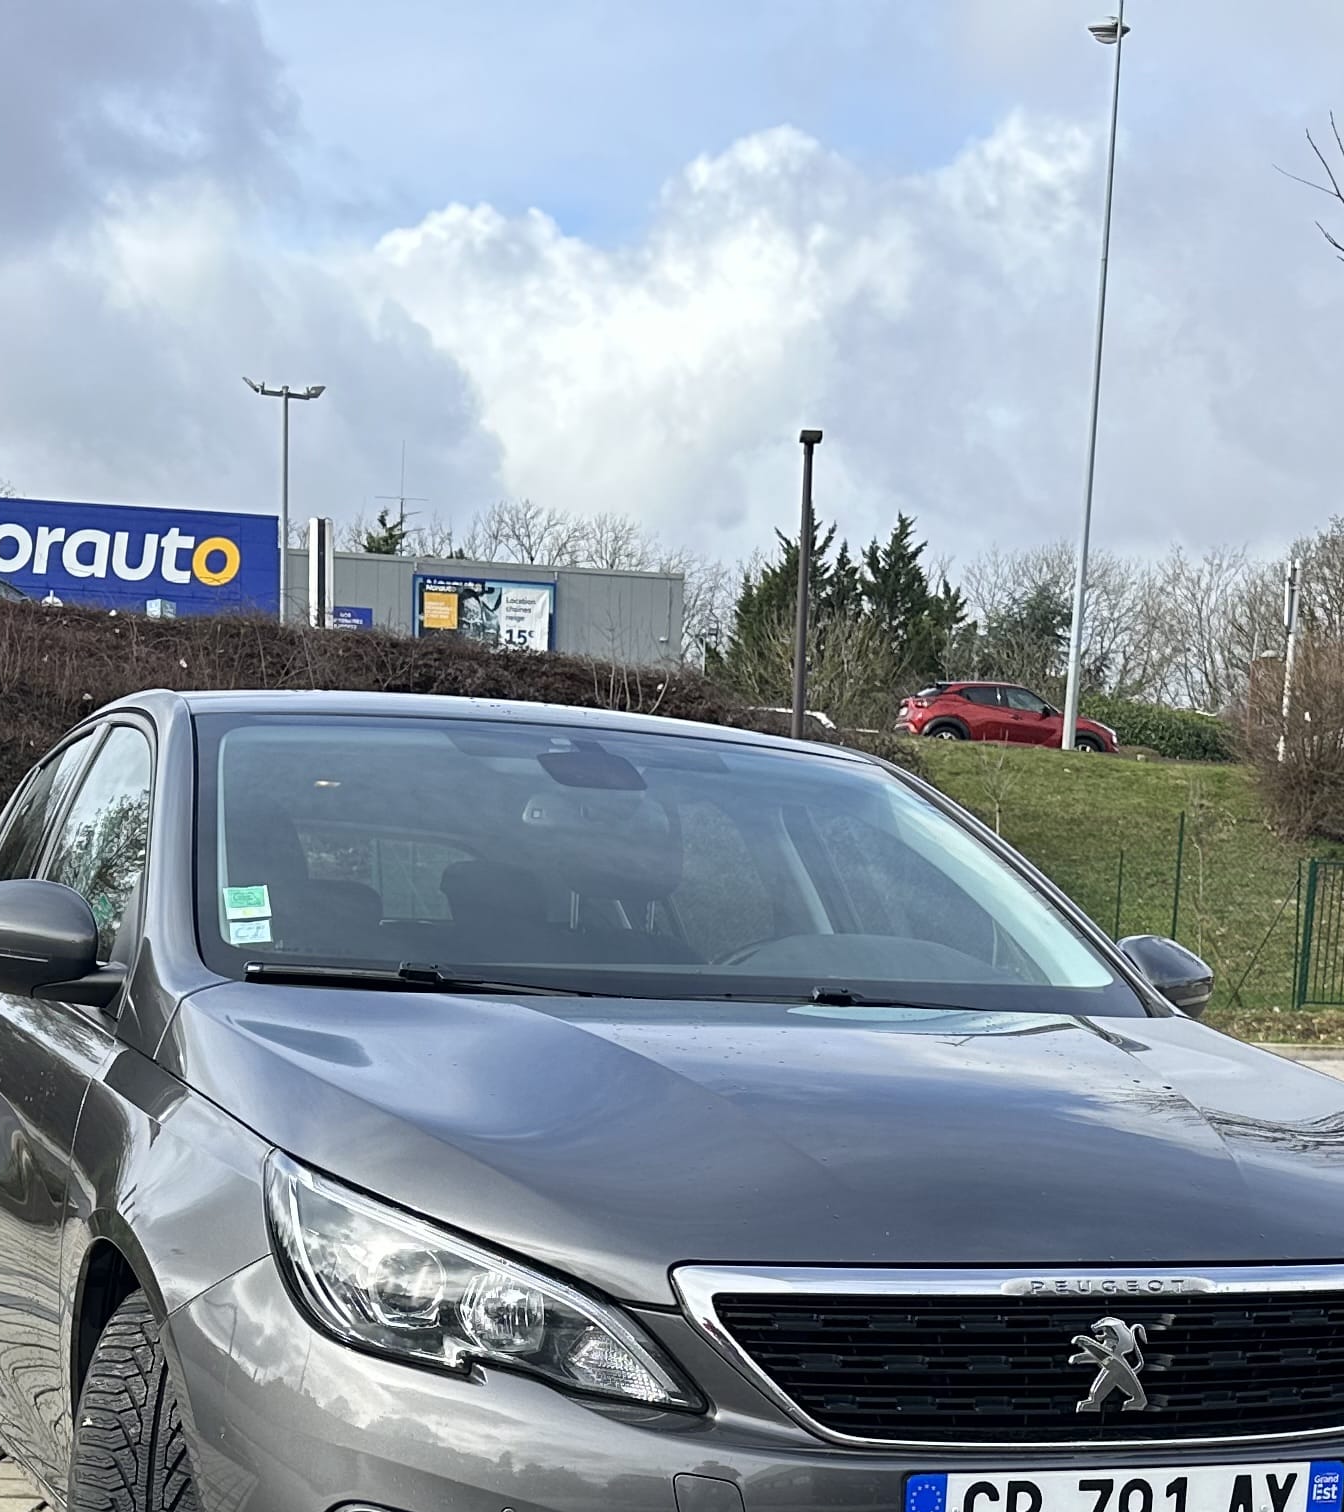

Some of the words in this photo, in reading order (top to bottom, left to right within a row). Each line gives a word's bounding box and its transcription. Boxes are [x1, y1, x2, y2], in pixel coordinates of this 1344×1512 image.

[1030, 1279, 1185, 1295] PEUGEOT
[1314, 1474, 1339, 1483] Grand
[1312, 1484, 1338, 1500] Est
